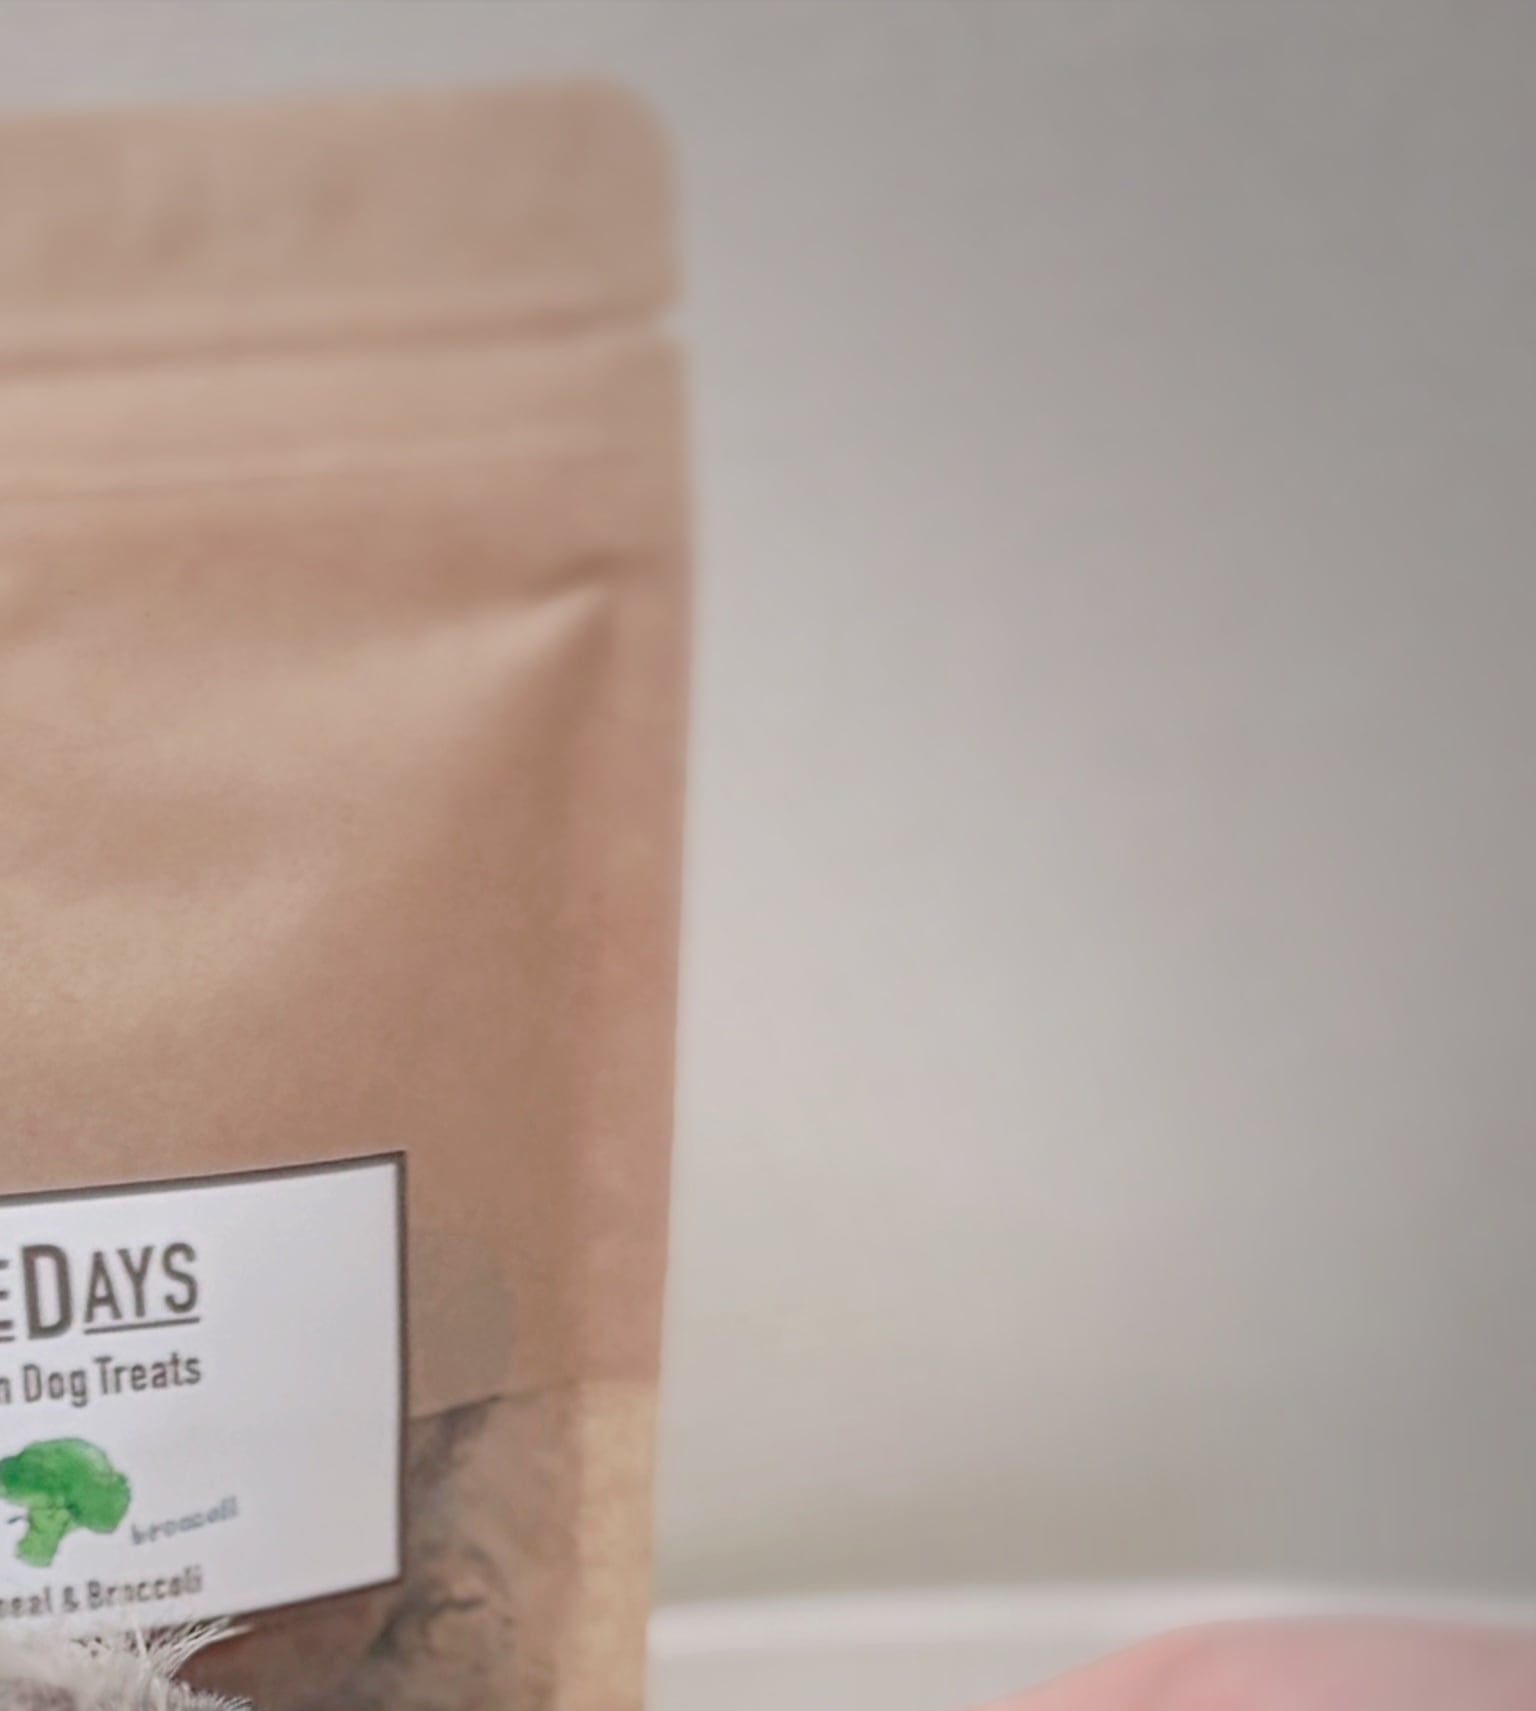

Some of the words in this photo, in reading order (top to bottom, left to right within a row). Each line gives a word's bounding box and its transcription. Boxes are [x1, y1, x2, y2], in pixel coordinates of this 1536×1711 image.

[21, 1363, 89, 1408] Dog
[94, 1350, 202, 1396] Treats
[63, 1585, 80, 1613] &
[86, 1564, 204, 1611] Broccoli
